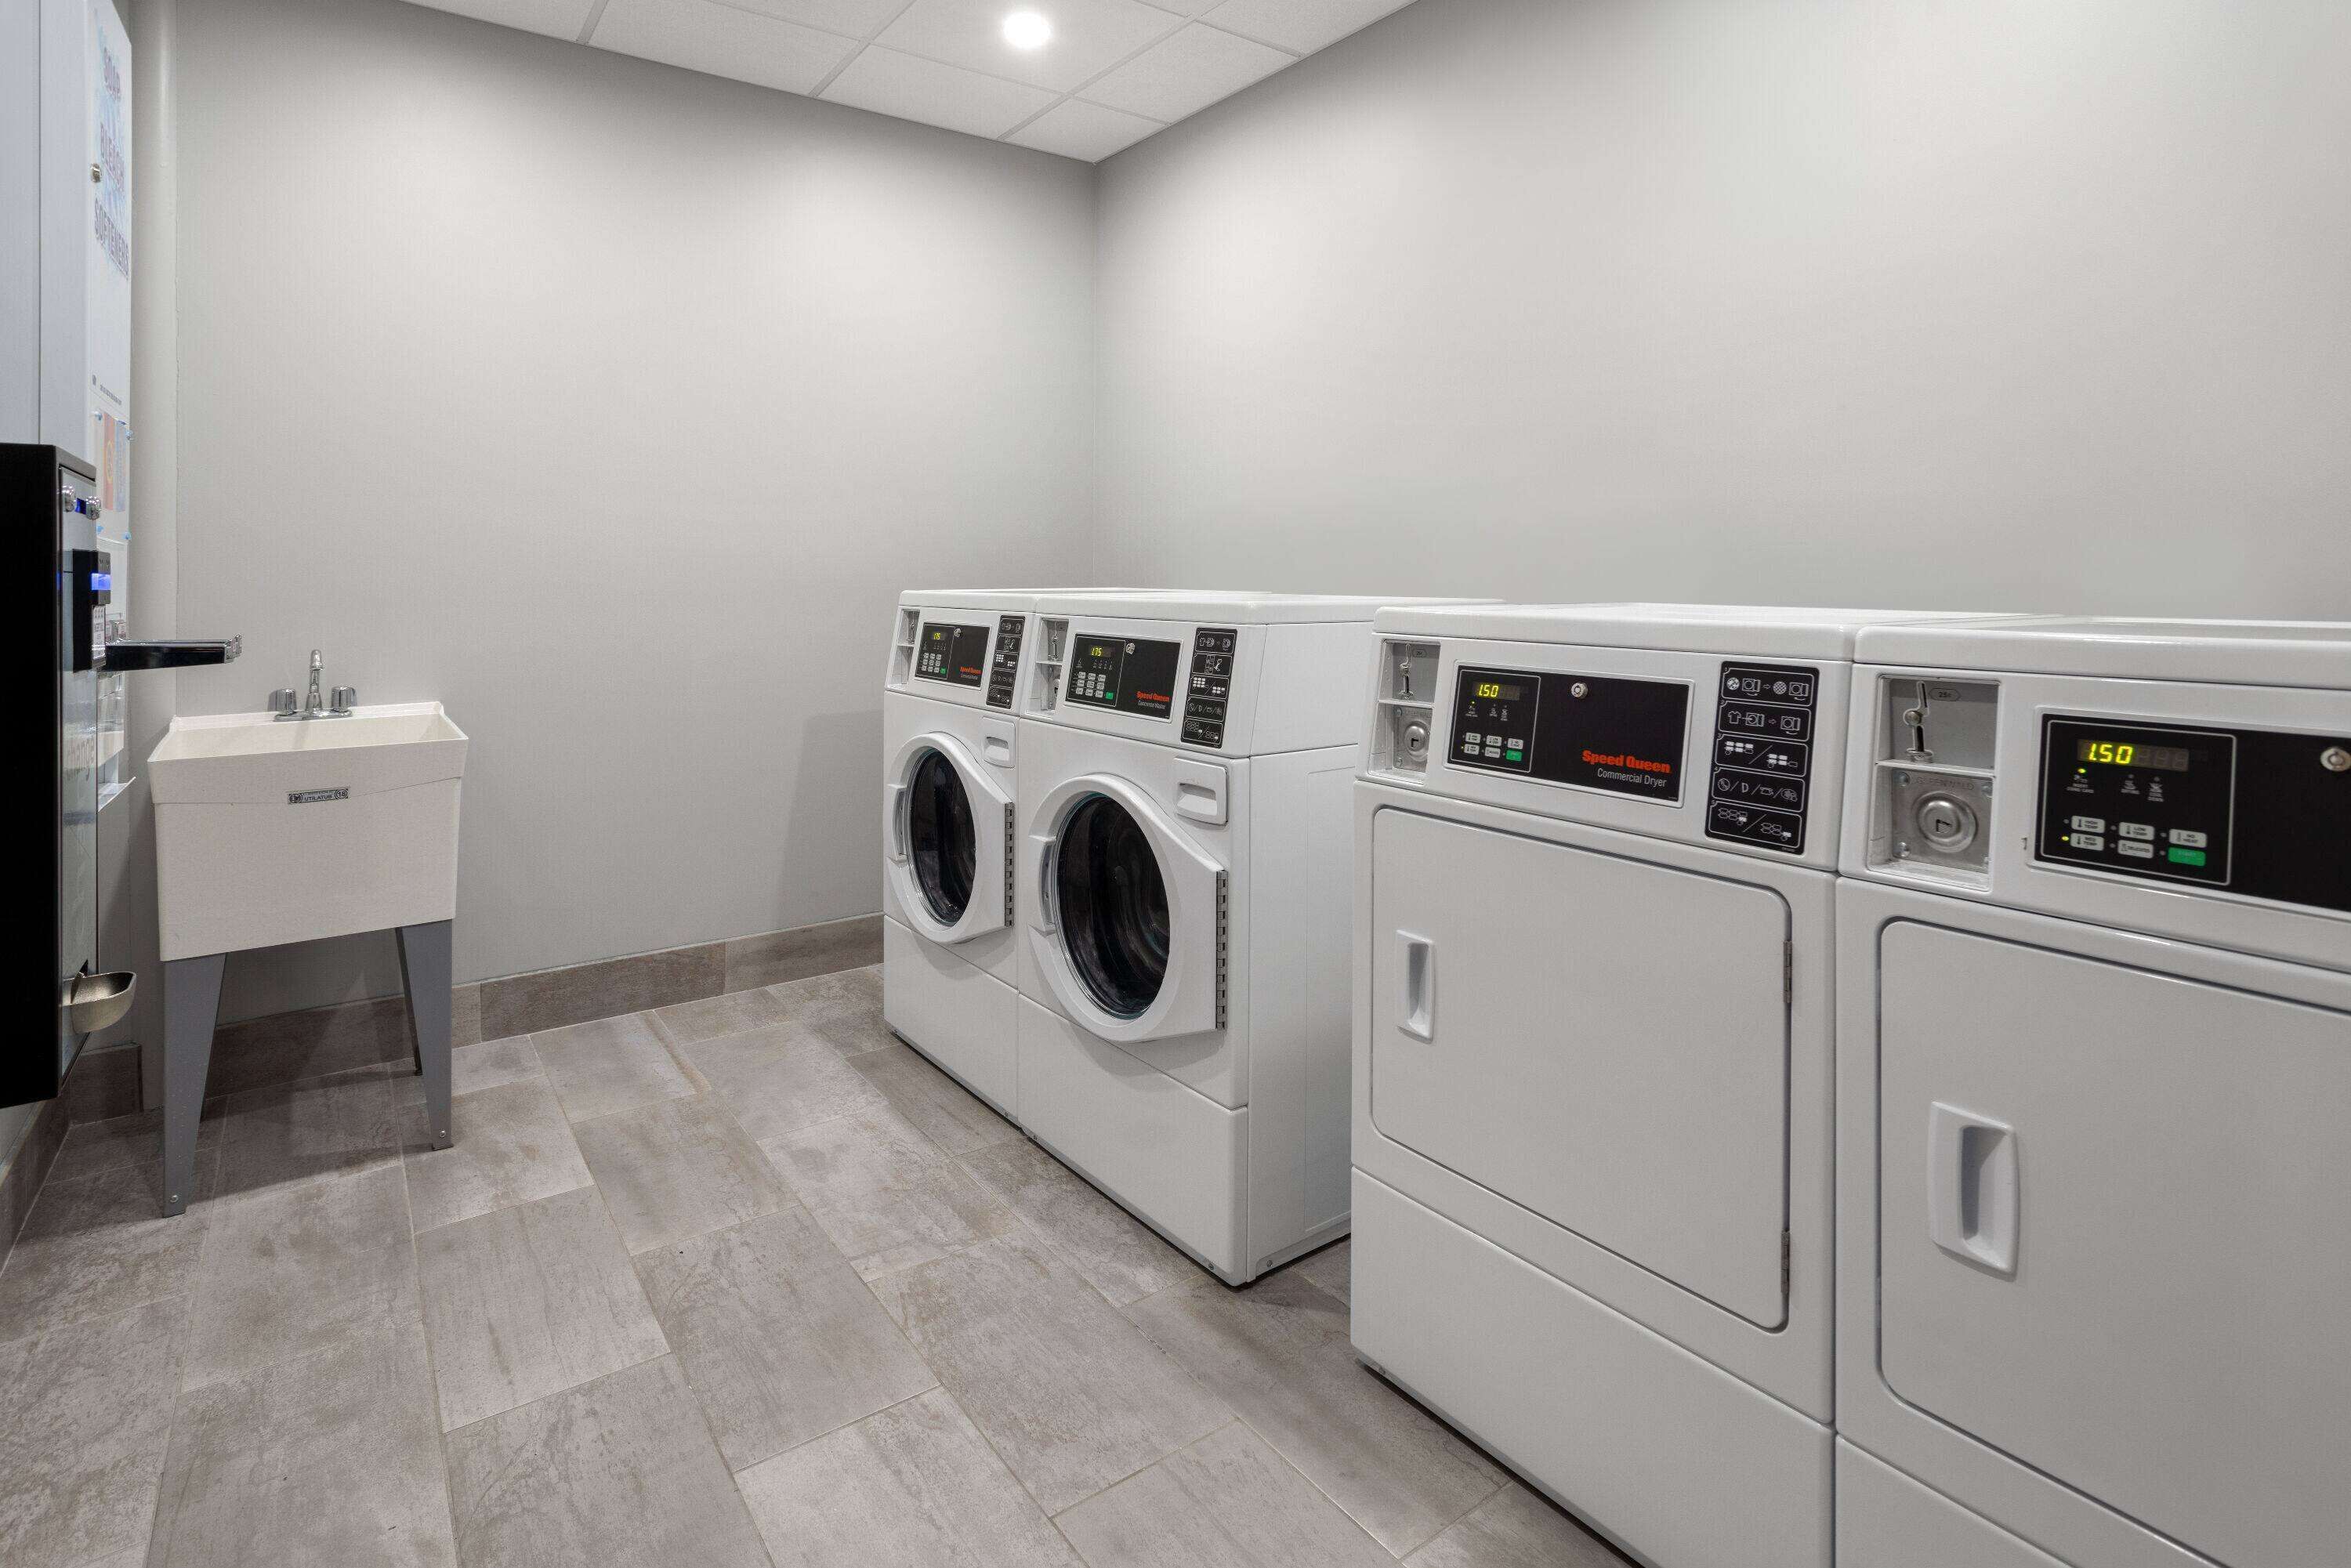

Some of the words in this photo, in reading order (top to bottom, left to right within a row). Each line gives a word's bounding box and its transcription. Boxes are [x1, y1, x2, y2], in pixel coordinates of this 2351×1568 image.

[95, 197, 129, 280] SOFTENERS
[1136, 691, 1153, 700] Speed
[1153, 693, 1170, 703] Queen
[1581, 749, 1625, 767] Speed
[1625, 755, 1672, 773] Queen
[1597, 768, 1643, 784] Commercial
[1644, 775, 1667, 788] Dryer
